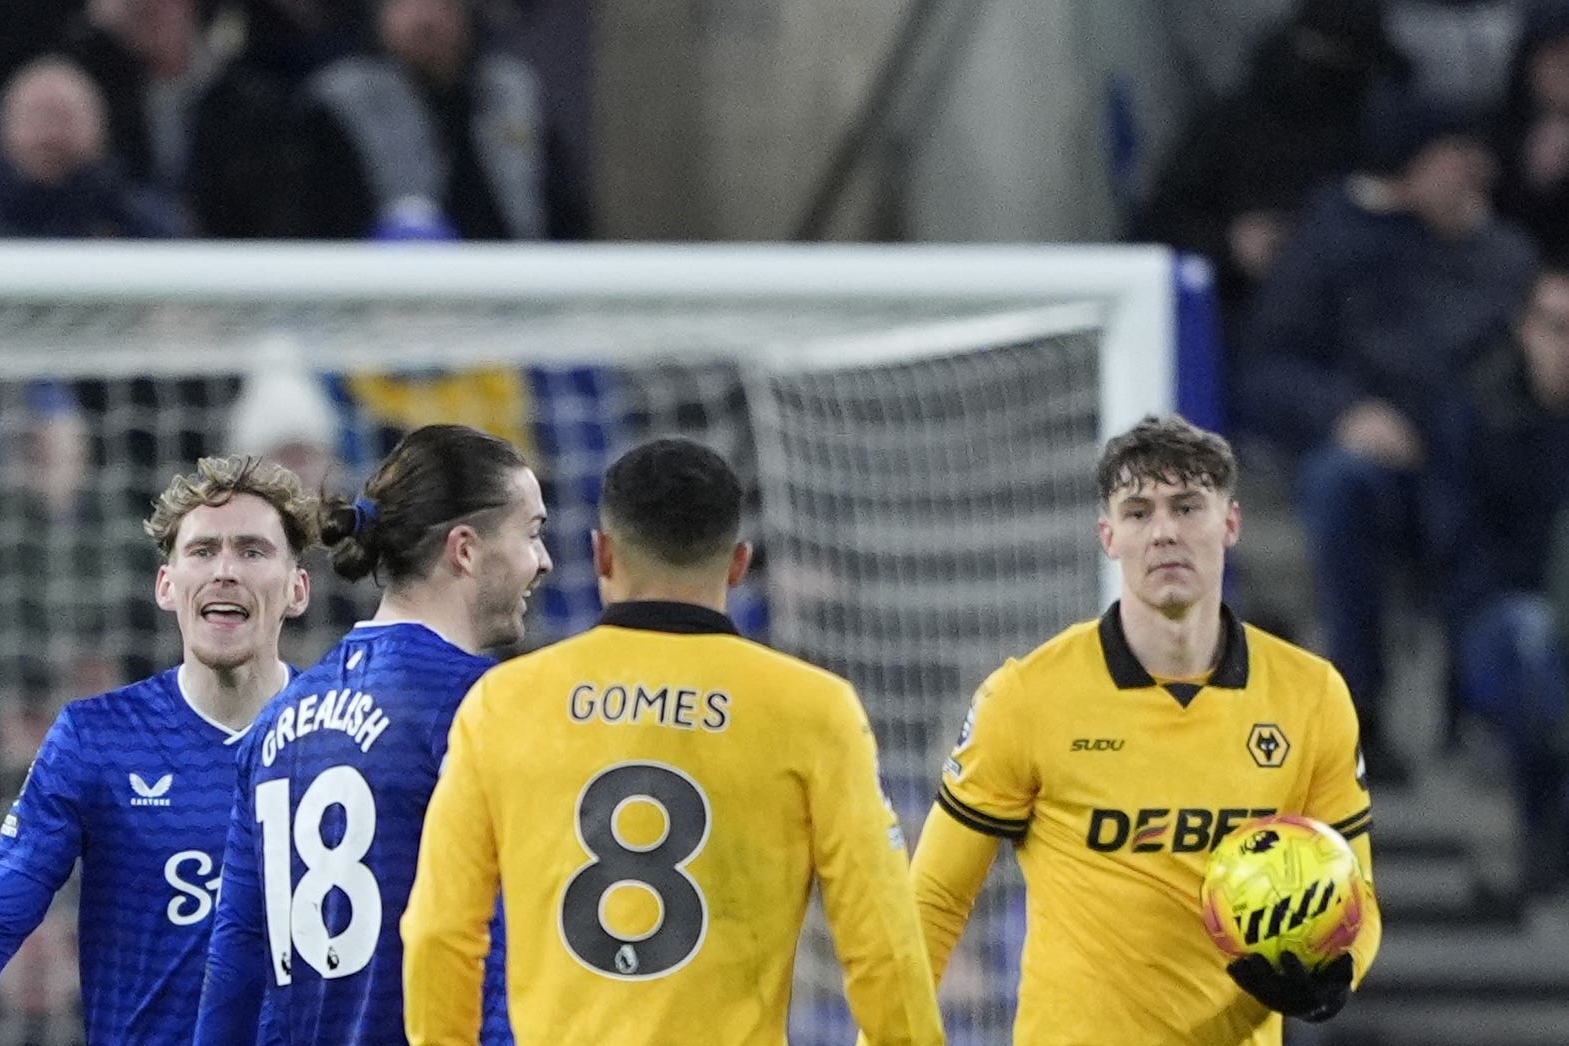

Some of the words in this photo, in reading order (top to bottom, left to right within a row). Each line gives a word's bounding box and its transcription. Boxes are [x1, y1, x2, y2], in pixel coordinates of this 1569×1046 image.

[261, 688, 391, 768] GREALISH
[569, 683, 732, 733] GOMES
[1070, 738, 1125, 753] SUDU
[255, 764, 382, 986] 18
[557, 758, 712, 982] 8
